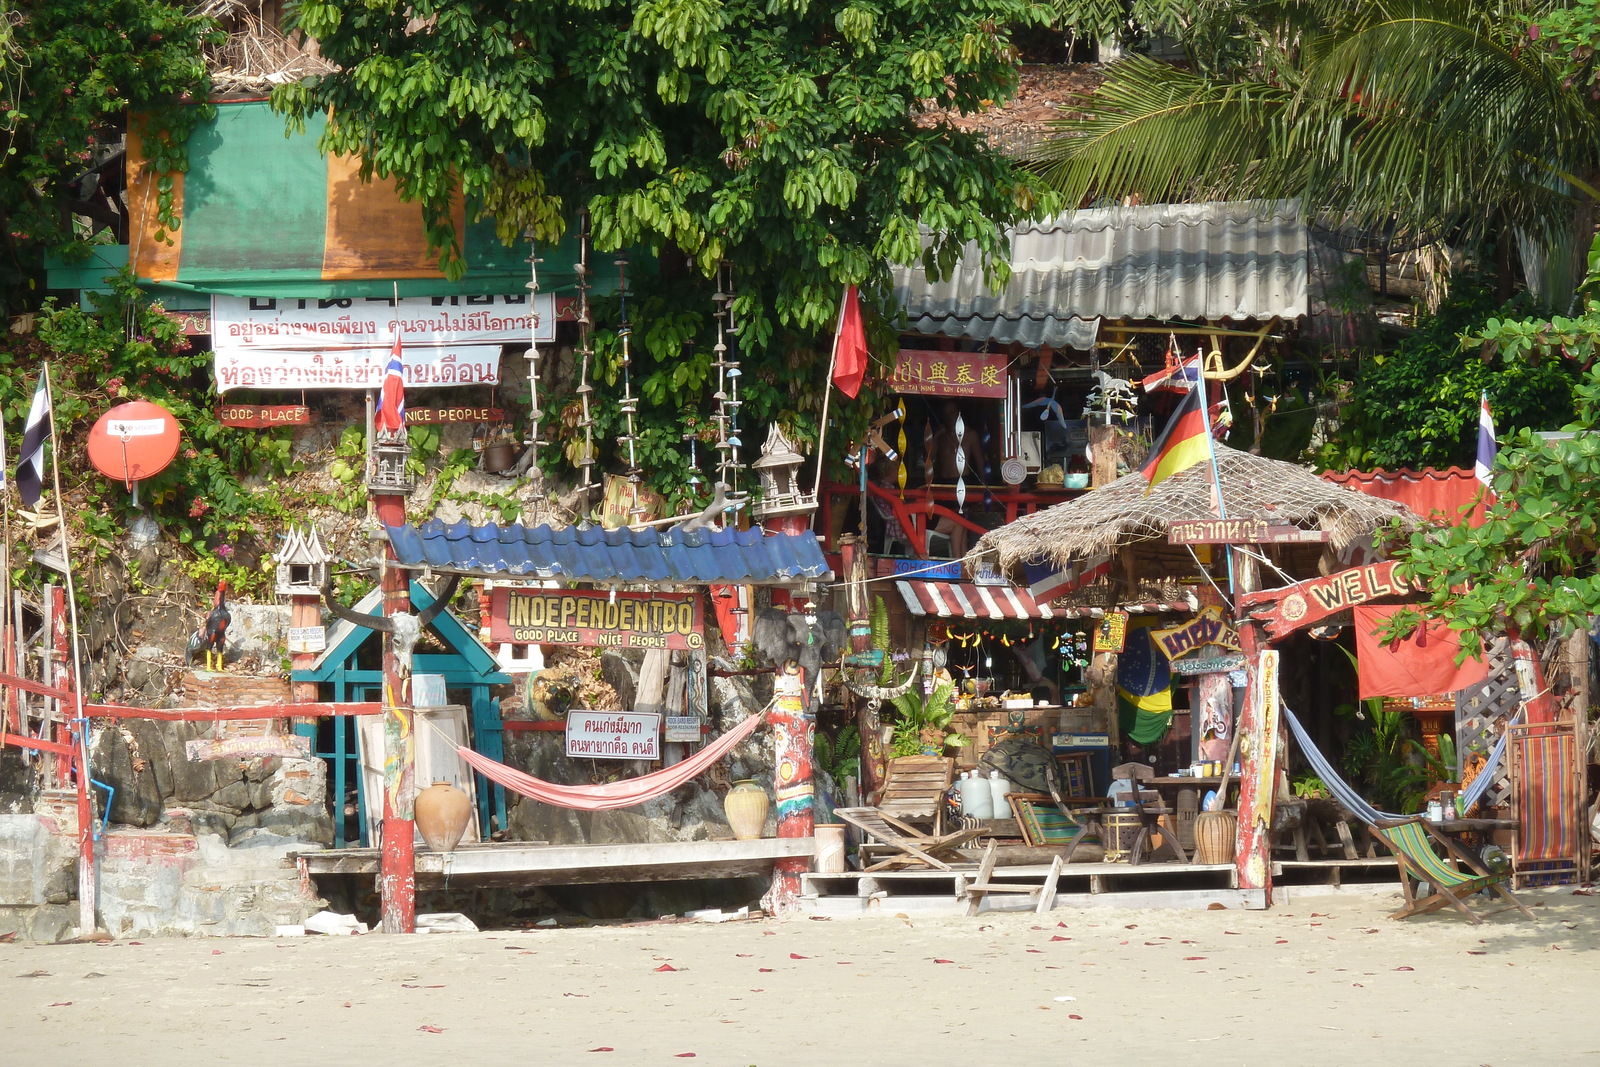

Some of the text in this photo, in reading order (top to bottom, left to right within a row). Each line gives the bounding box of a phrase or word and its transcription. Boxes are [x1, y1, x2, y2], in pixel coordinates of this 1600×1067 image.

[220, 354, 496, 386] ห้องว่างให้เช่าายเดือน
[956, 386, 974, 394] CHANG
[221, 409, 302, 421] GOOD PLACE
[405, 408, 489, 422] NICE PEOPLE
[895, 562, 959, 575] KOH CHANG
[514, 628, 543, 641] GOOD
[547, 630, 579, 643] PLACE
[629, 634, 666, 648] PEOPLE
[584, 716, 642, 734] คนเก่งมีมาก
[570, 735, 654, 755] คนหายากคือ คนดี
